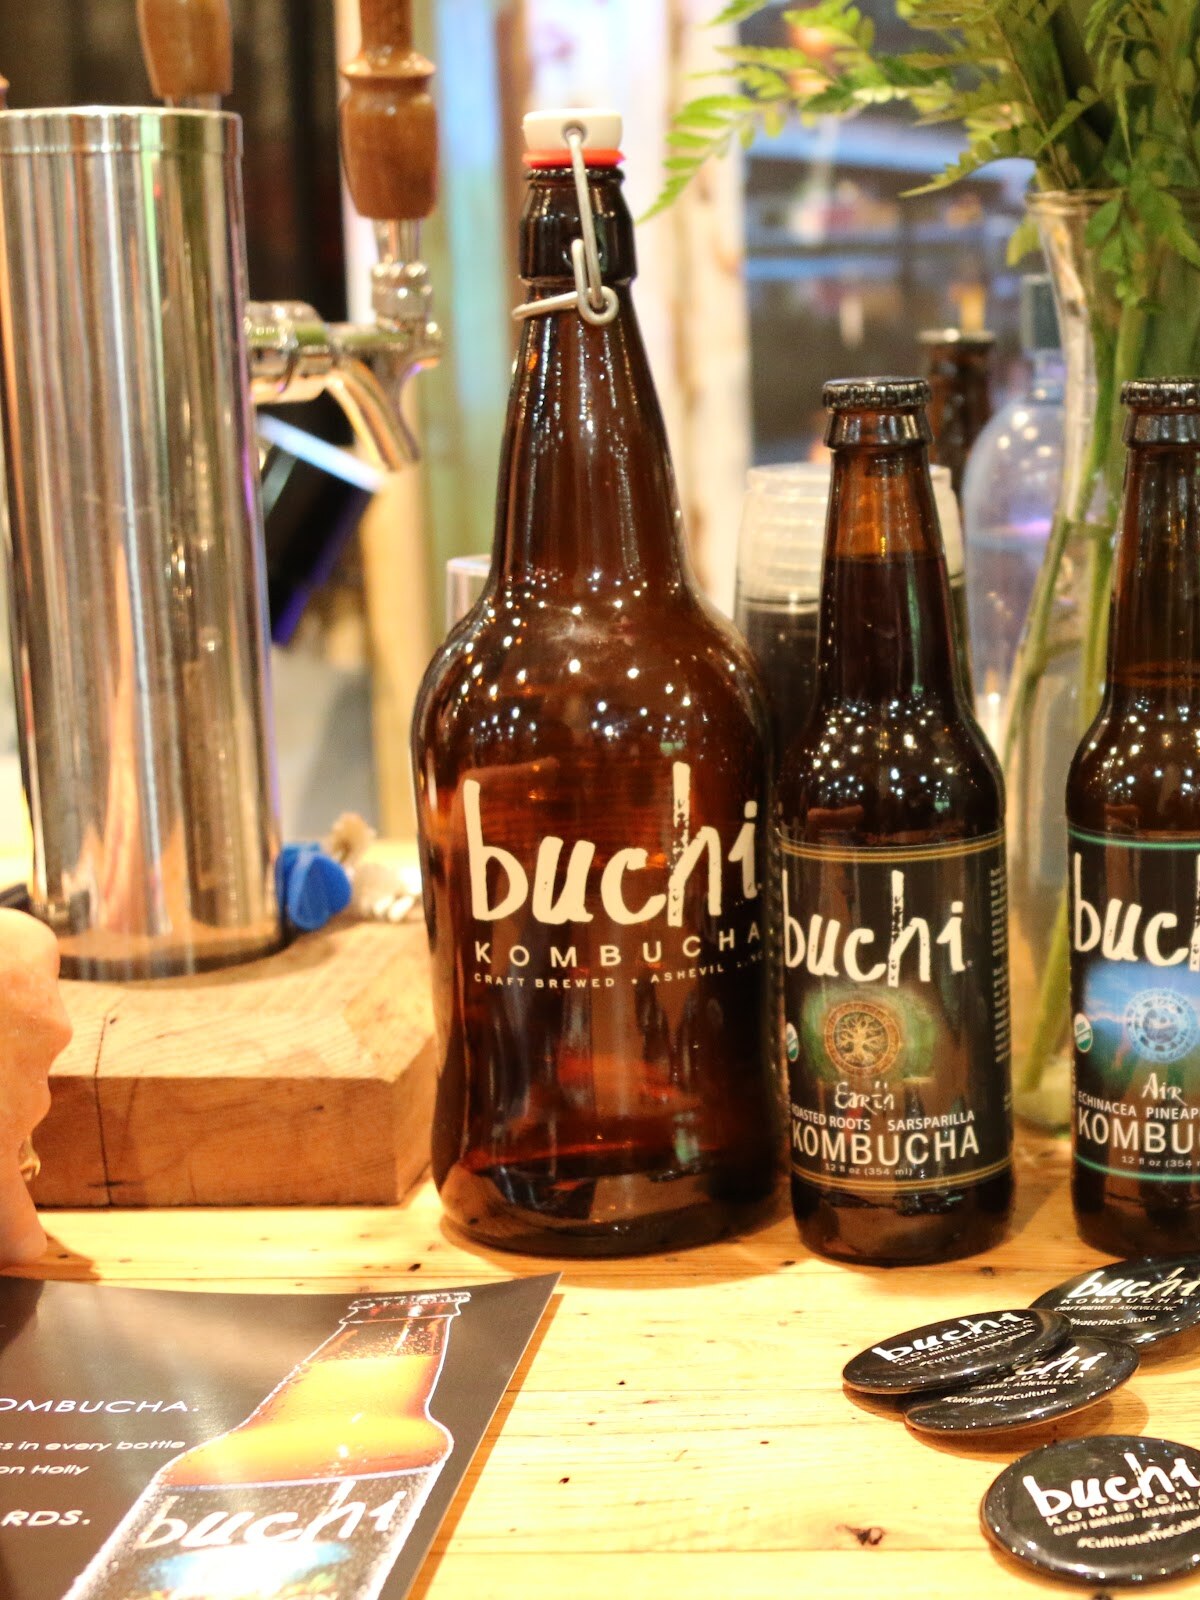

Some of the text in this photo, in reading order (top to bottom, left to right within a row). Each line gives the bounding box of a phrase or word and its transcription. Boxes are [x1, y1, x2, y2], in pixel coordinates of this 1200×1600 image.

[463, 760, 758, 928] buchi
[474, 920, 761, 969] KOMBUCHA
[782, 868, 966, 988] buchi
[473, 972, 526, 988] CRAFT
[534, 977, 616, 989] BREWED
[829, 1115, 871, 1132] ROOTS
[887, 1109, 976, 1132] SARSPARILLA
[1078, 1090, 1138, 1117] ECHINACEA
[792, 1119, 980, 1166] KOMBUCHA
[1121, 1155, 1135, 1165] 12
[1149, 1158, 1161, 1168] oz
[1164, 1158, 1192, 1169] (354
[1060, 1297, 1184, 1305] KOMBUCHA
[872, 1312, 1024, 1362] buchi
[18, 1440, 40, 1451] in
[45, 1442, 112, 1452] every
[116, 1439, 186, 1450] bottle
[31, 1463, 90, 1475] Holly
[1022, 1452, 1200, 1518] buchi
[136, 1479, 407, 1550] buchi
